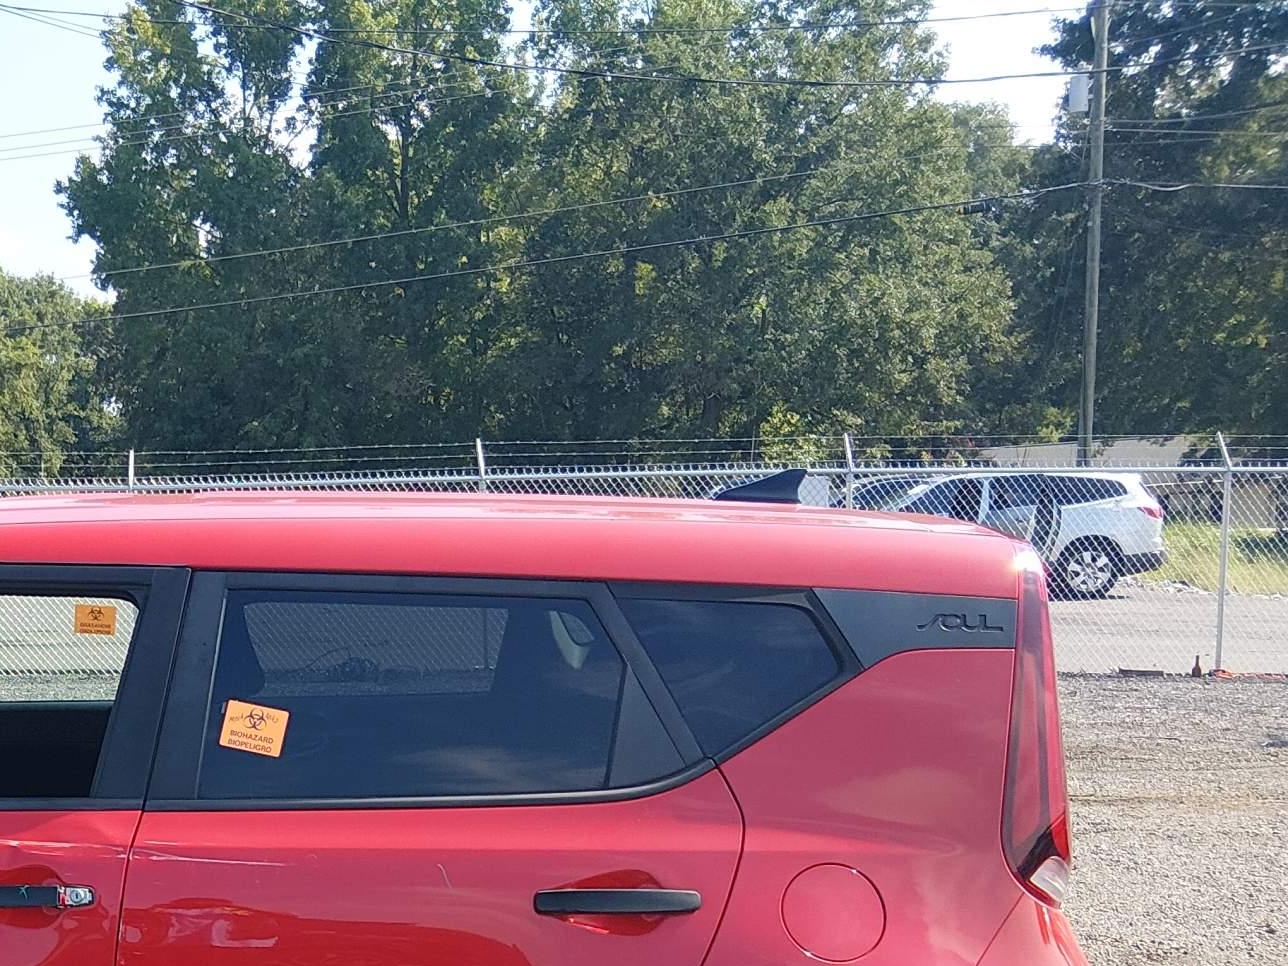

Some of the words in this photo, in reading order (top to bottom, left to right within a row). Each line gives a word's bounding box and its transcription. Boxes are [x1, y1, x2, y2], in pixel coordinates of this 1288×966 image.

[916, 613, 1003, 632] SOUL
[229, 730, 274, 744] BIOHAZARD
[227, 739, 272, 753] BIOPELIGRO
